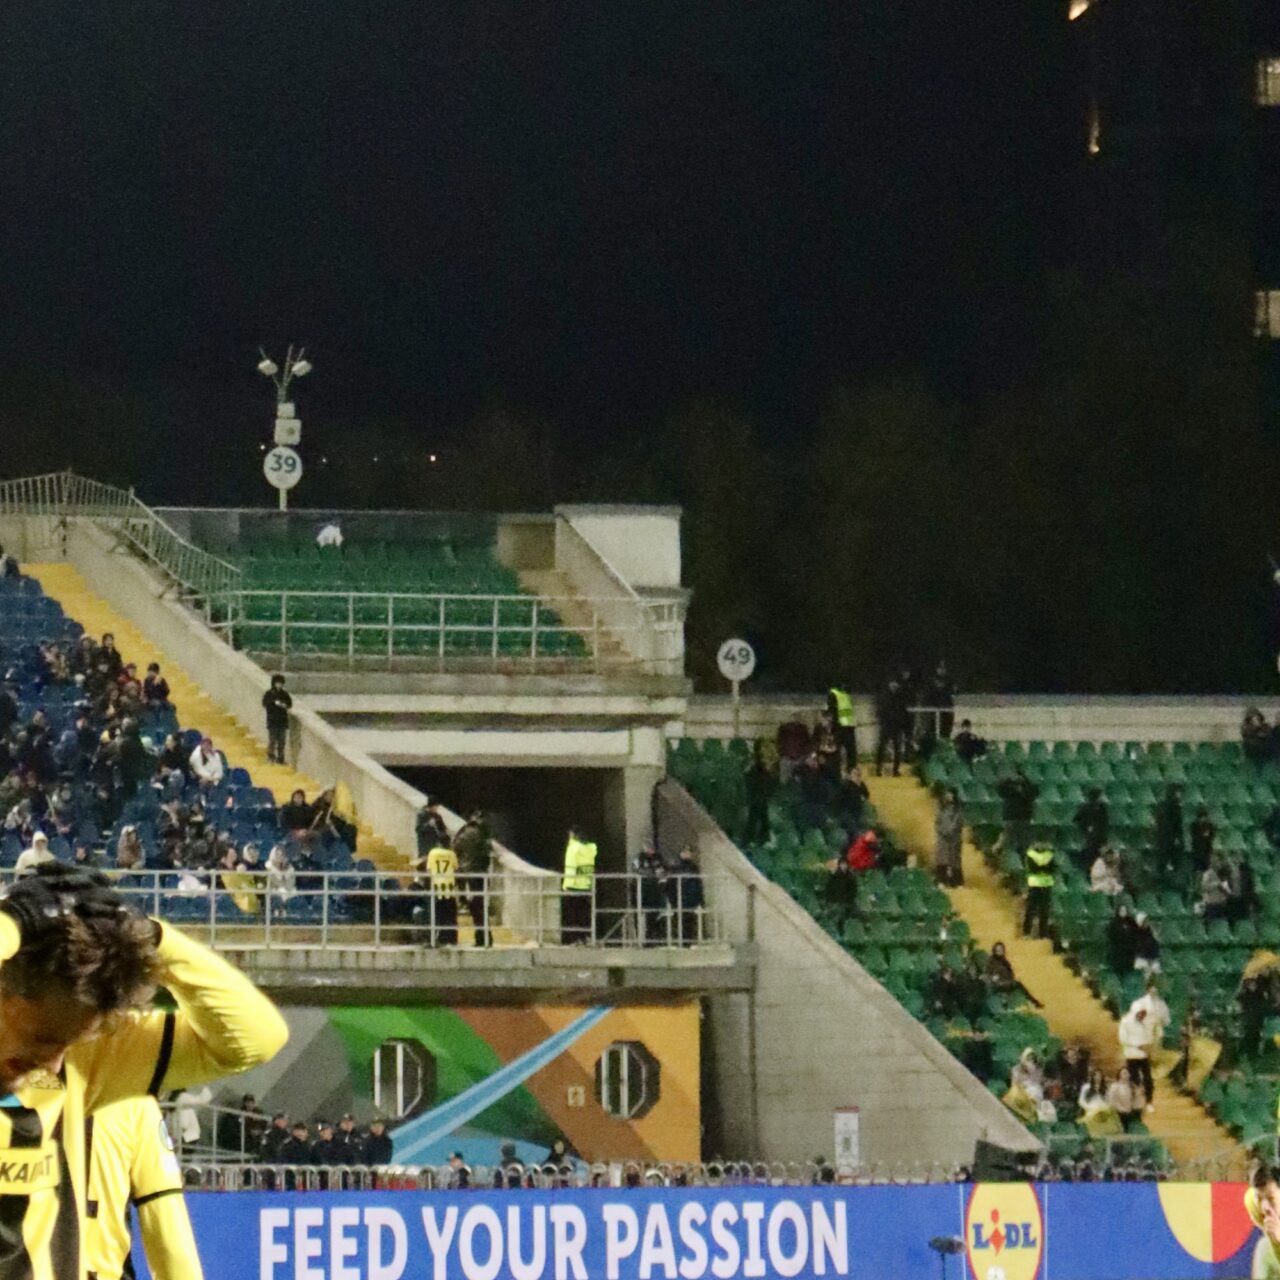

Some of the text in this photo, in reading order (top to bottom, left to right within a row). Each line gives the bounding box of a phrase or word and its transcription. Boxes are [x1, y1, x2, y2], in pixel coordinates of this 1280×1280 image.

[270, 453, 297, 474] 39
[723, 646, 751, 665] 49
[435, 860, 450, 874] 17
